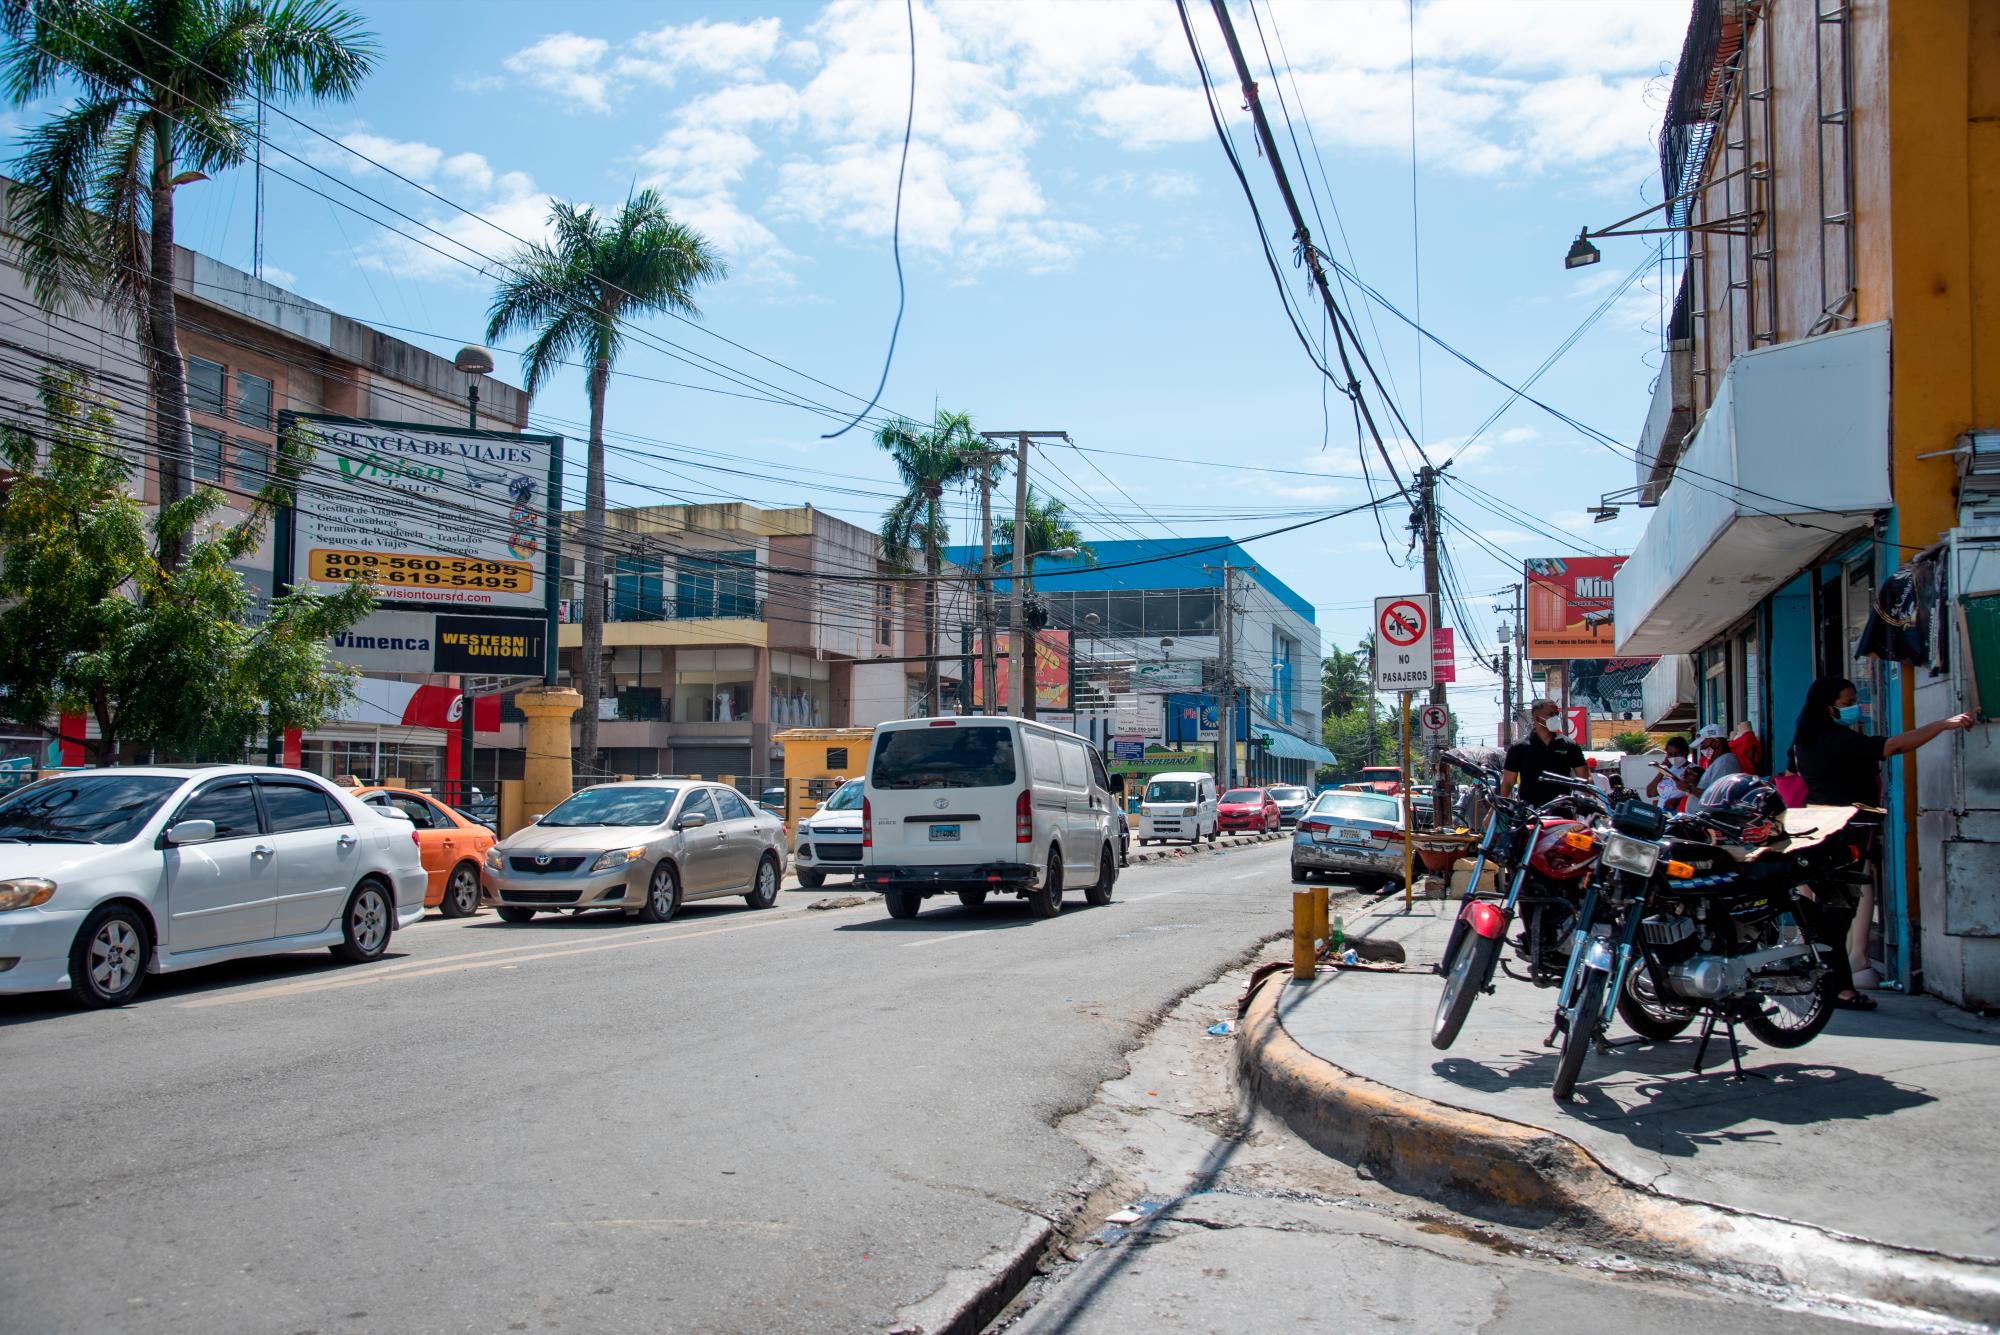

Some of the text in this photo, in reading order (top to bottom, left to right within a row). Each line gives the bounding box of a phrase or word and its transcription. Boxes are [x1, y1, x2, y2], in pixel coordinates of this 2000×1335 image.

[321, 431, 532, 463] AGENCIA DE VIAJES
[382, 478, 440, 494] Tours
[344, 515, 398, 527] Consulares
[317, 523, 357, 534] Permiso
[373, 527, 424, 539] Residencia
[436, 533, 483, 544] Traslados
[316, 535, 408, 550] Seguros de Viajes
[325, 553, 518, 576] 809-560-5495
[325, 567, 518, 589] 809-619-5495
[334, 631, 430, 651] Vimenca
[442, 632, 524, 647] WESTERN
[468, 645, 524, 657] UNION
[1398, 654, 1410, 664] NO
[1382, 670, 1428, 682] PASAJEROS
